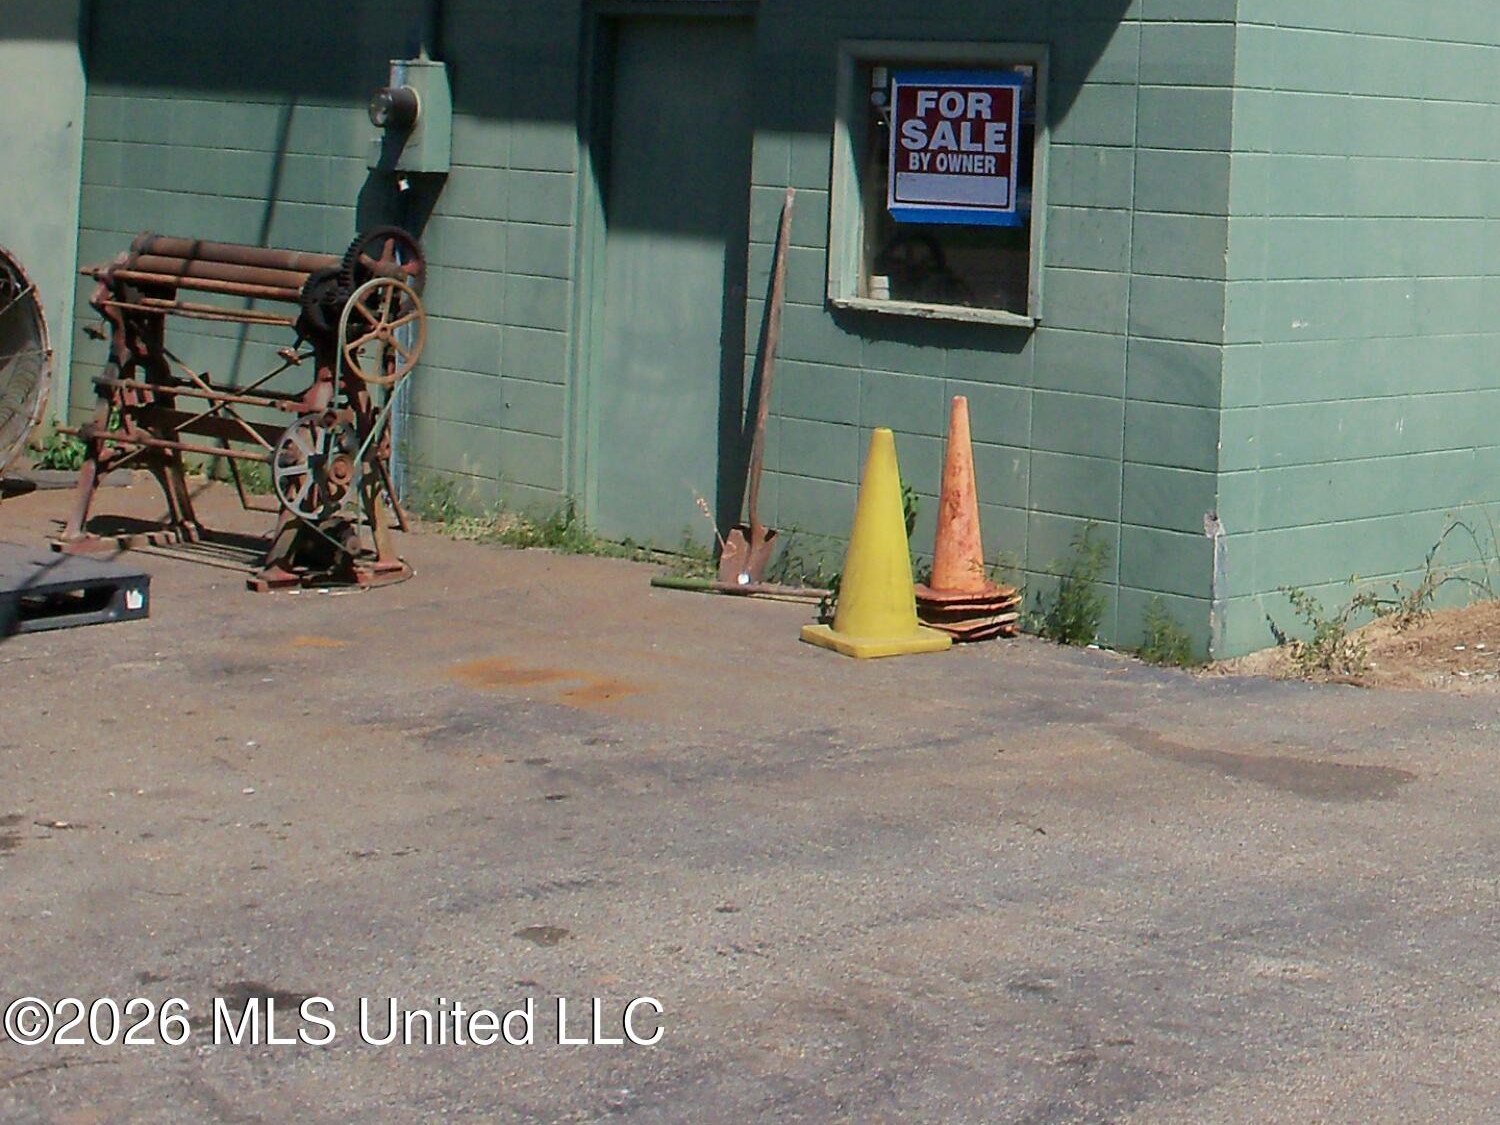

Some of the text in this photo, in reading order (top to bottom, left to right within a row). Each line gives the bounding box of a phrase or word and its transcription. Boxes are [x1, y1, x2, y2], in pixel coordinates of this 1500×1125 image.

[916, 91, 992, 120] FOR
[901, 119, 1007, 153] SALE
[909, 152, 997, 174] BY OWNER
